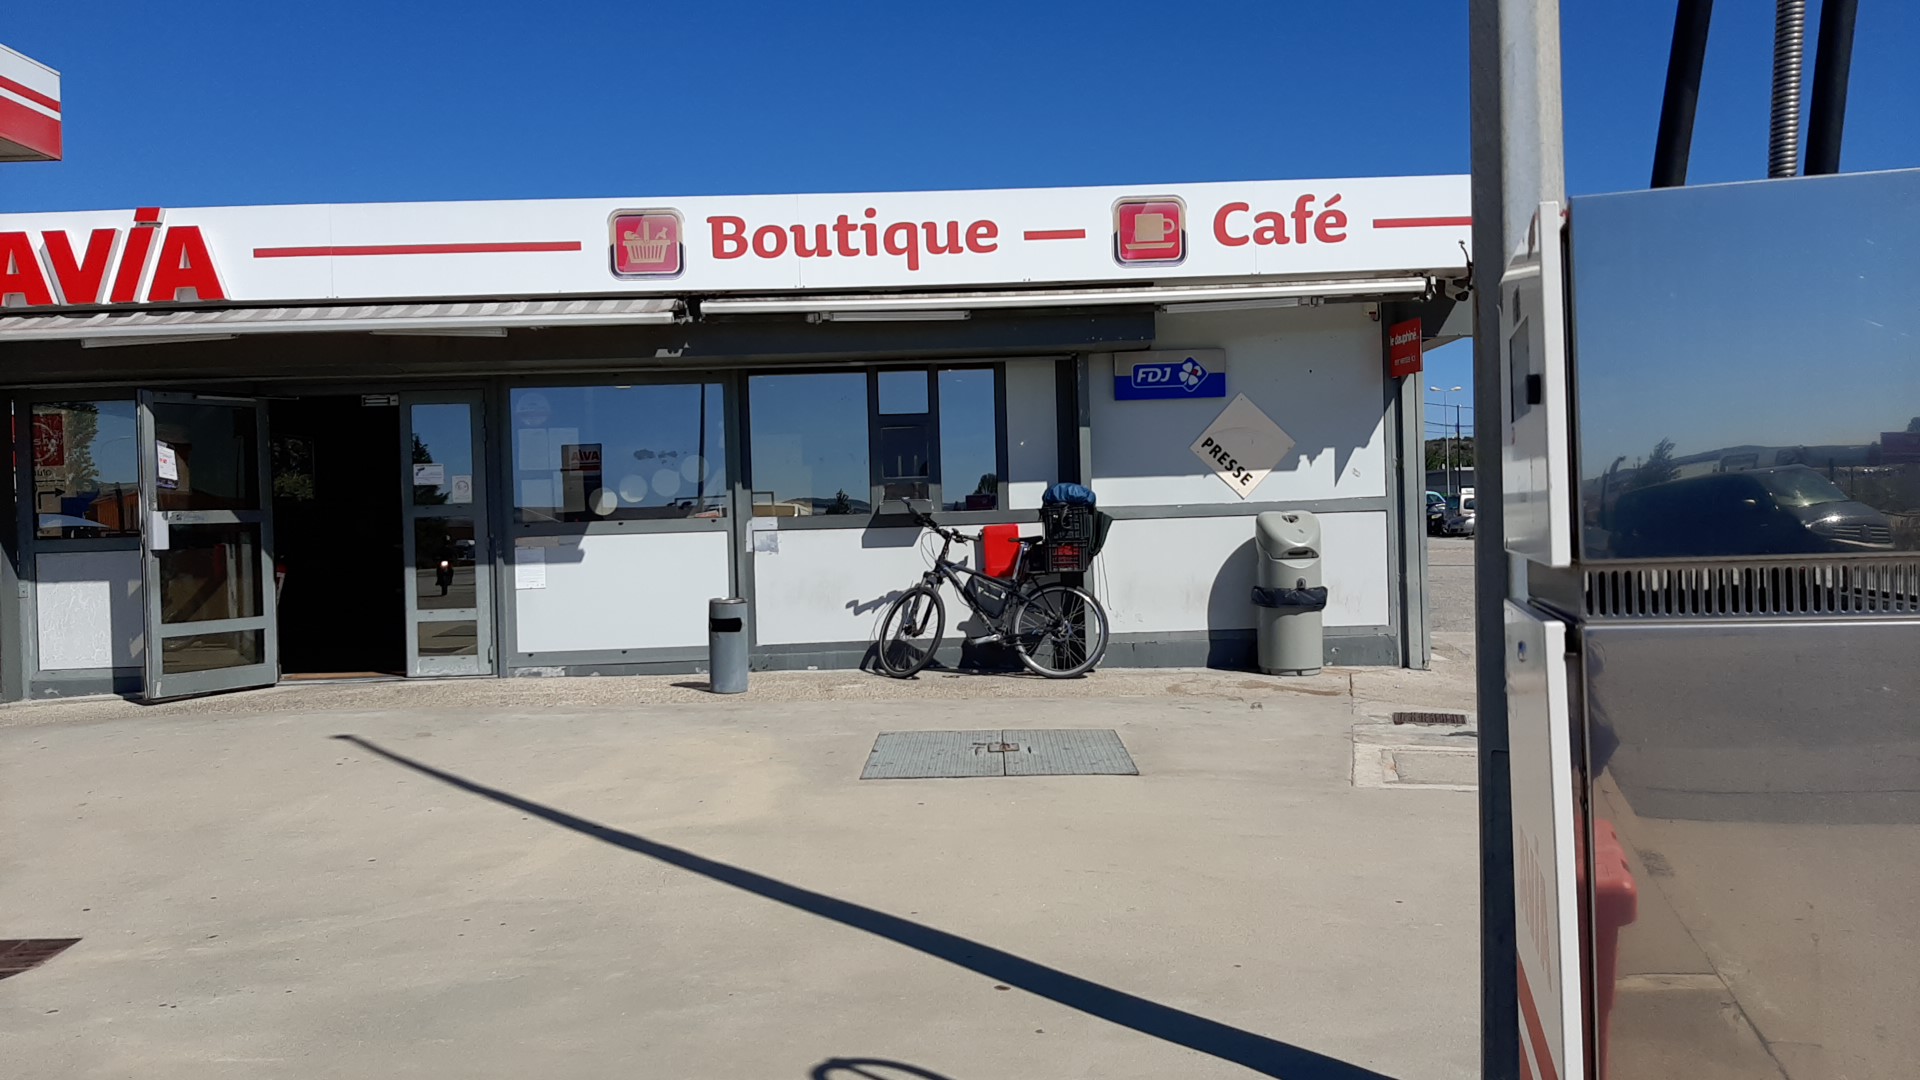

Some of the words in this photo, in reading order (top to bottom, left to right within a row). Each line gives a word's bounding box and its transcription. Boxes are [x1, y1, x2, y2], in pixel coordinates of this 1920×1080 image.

[706, 207, 998, 271] Boutique
[1213, 193, 1347, 247] Café
[1136, 367, 1171, 383] FDJ
[1201, 437, 1253, 486] PRESSE
